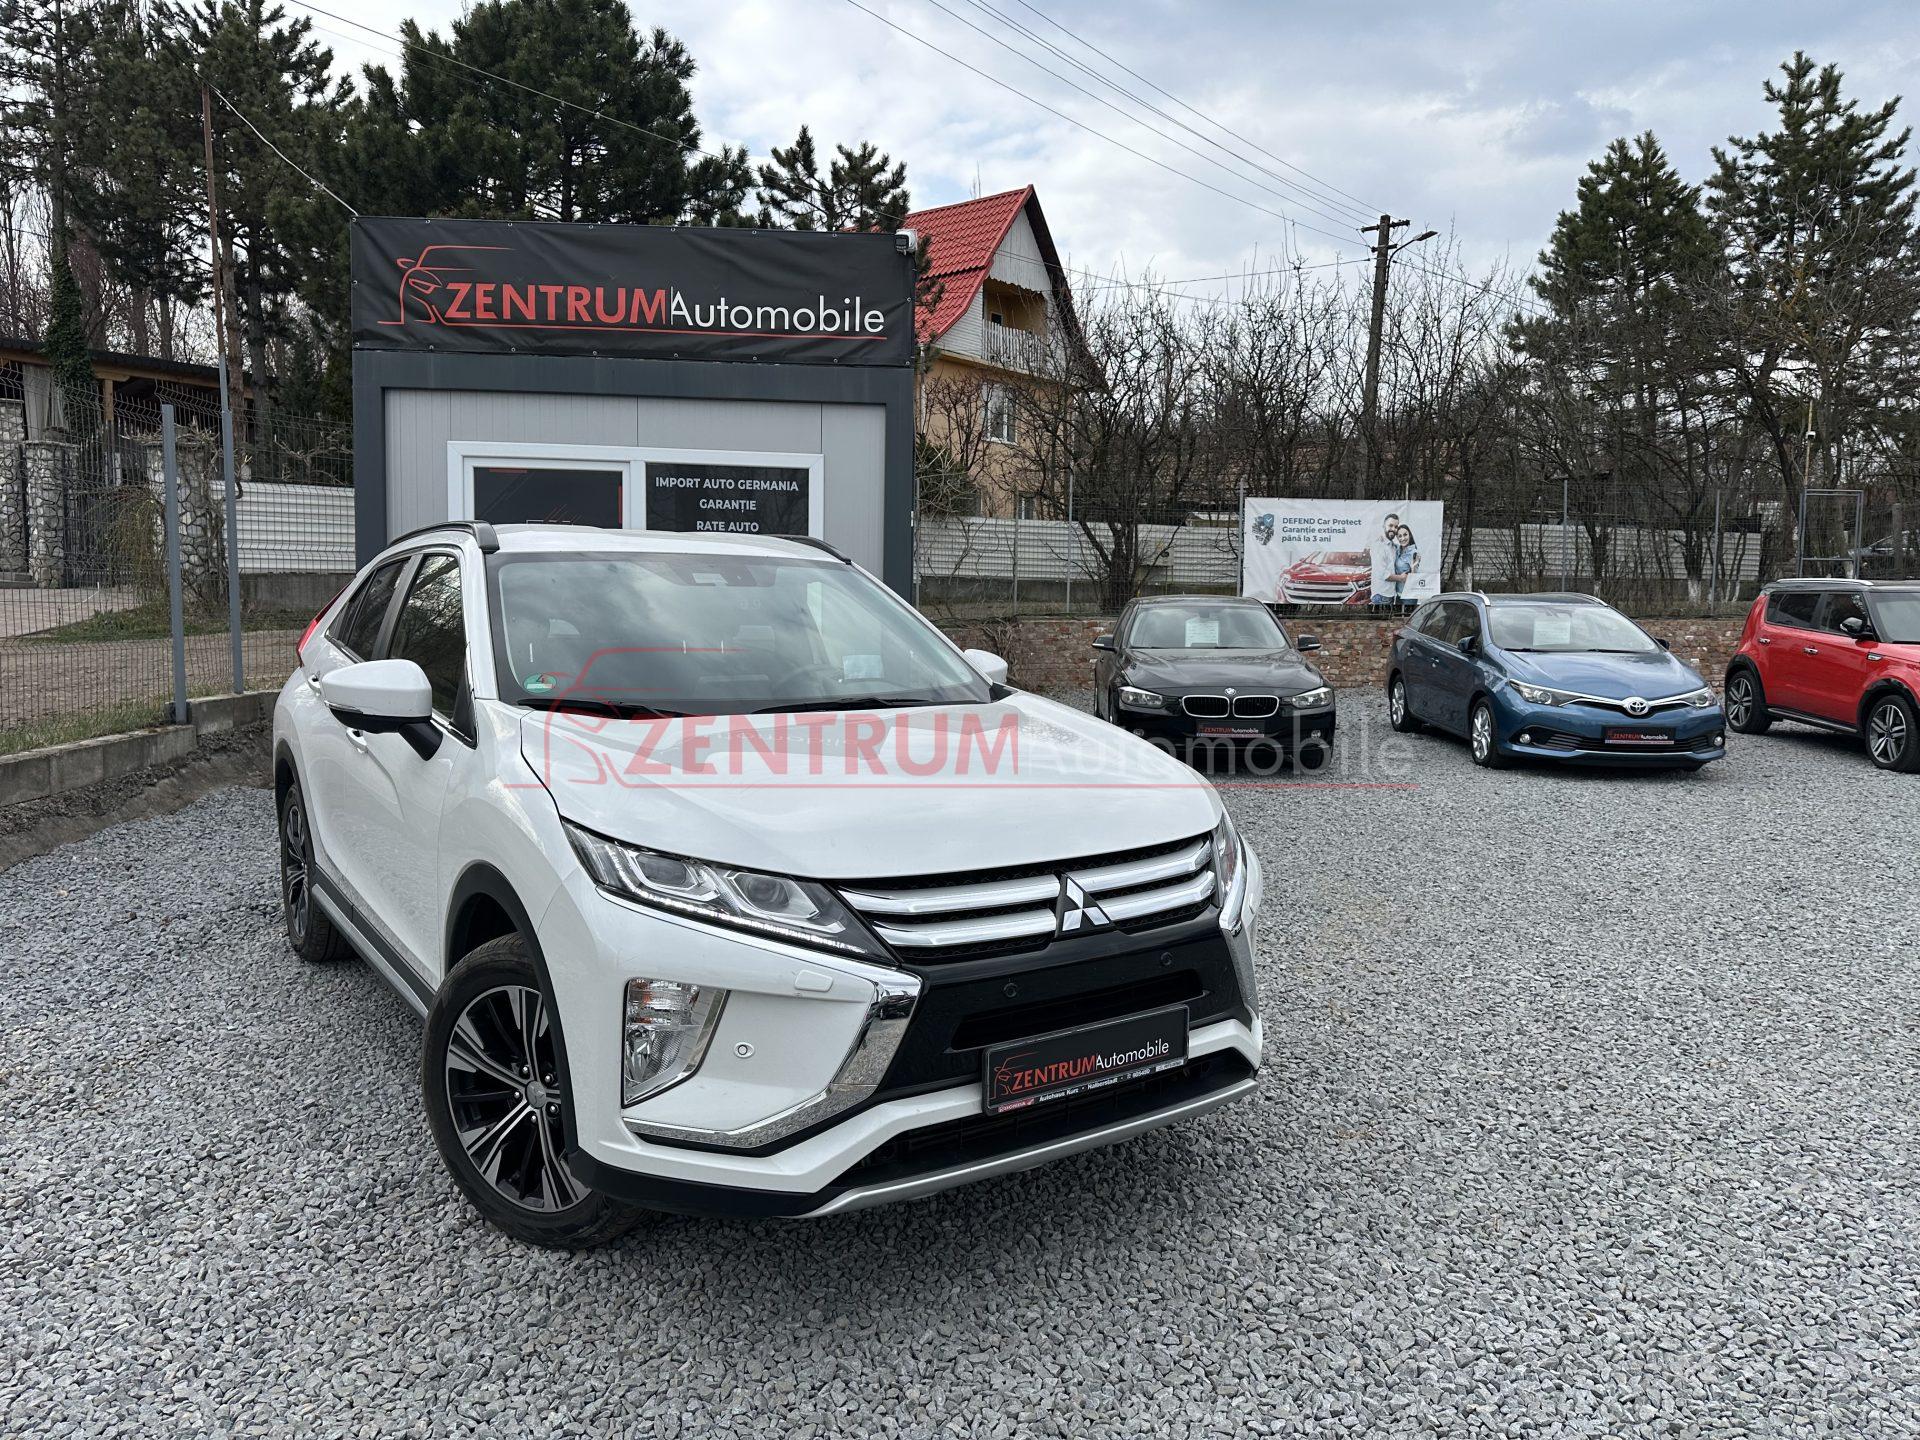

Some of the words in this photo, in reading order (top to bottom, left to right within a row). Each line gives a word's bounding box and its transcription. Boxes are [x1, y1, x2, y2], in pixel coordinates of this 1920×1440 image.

[446, 282, 666, 324] ZENTRUM
[671, 291, 885, 332] Automobile
[656, 477, 701, 489] IMPORT
[703, 479, 735, 490] AUTO
[737, 480, 799, 491] GERMANIA
[696, 520, 726, 531] RATE
[728, 521, 759, 532] AUTO
[1282, 517, 1316, 525] DEFEND
[1333, 518, 1362, 526] Protect
[1318, 526, 1346, 534] extinsă
[1319, 535, 1332, 543] ani
[1011, 1055, 1097, 1091] ZENTRUM
[1096, 1038, 1169, 1070] Automobile
